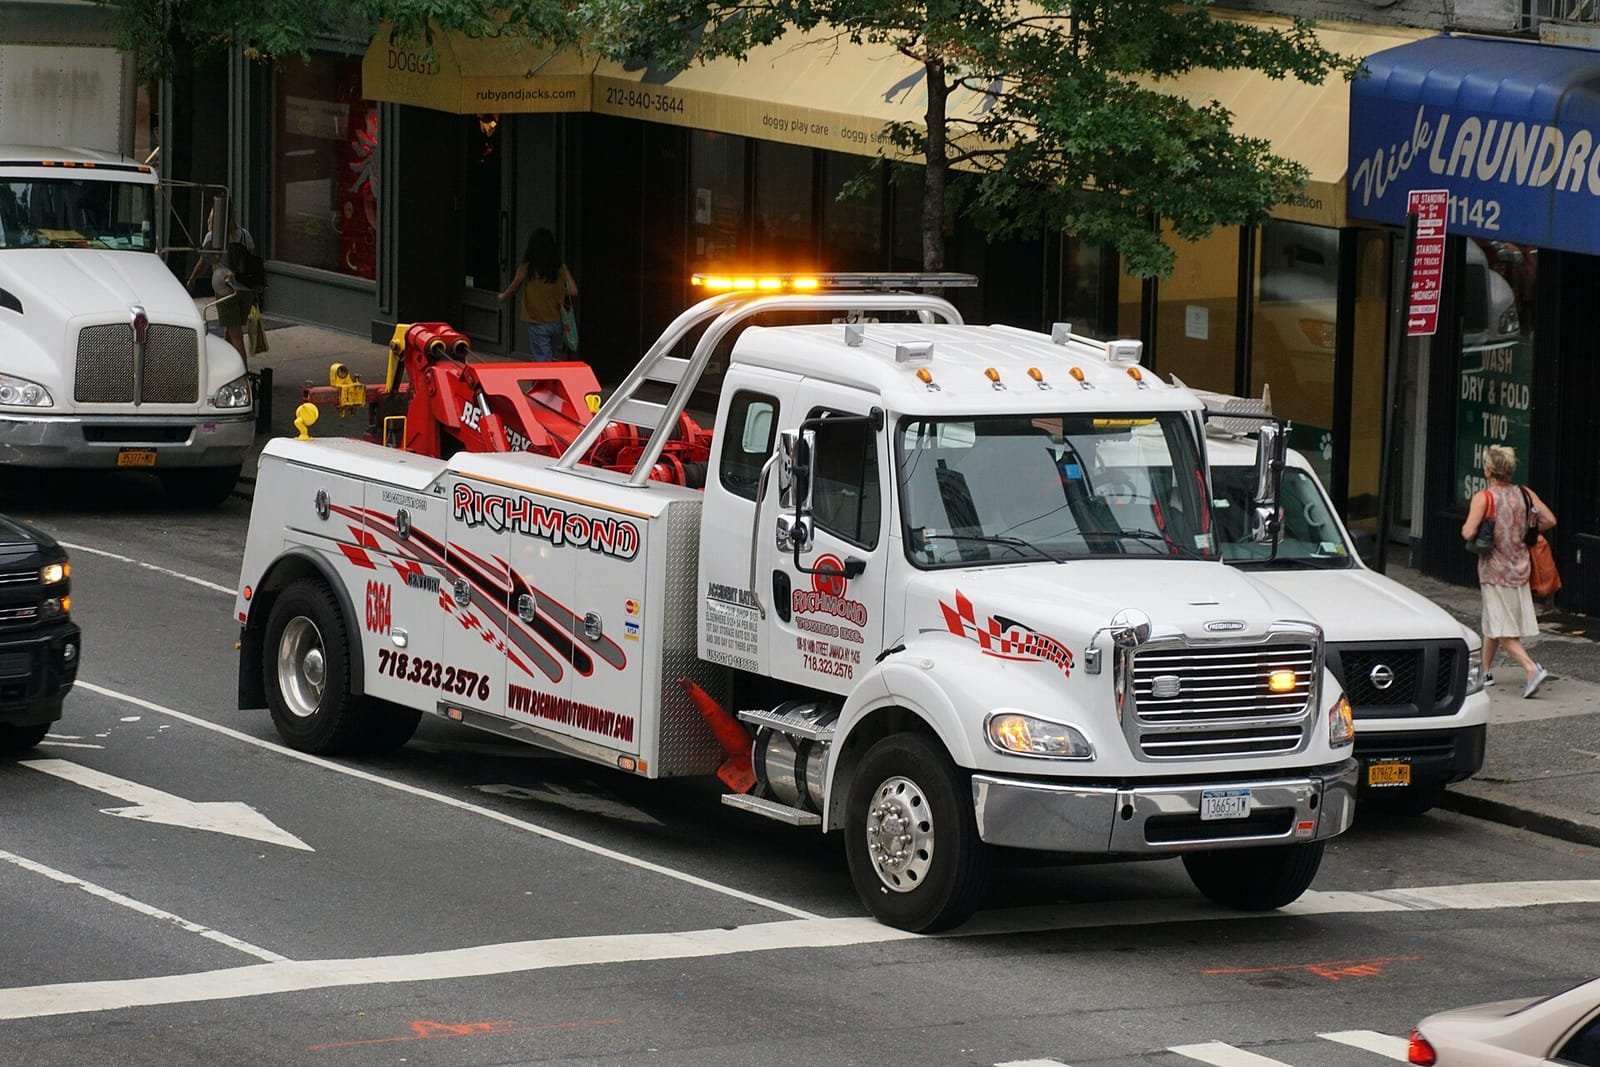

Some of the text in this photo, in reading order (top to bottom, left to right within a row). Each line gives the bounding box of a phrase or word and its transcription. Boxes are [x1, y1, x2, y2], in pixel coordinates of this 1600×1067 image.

[476, 88, 576, 101] rubyandjacks.com
[606, 88, 684, 114] 212-840-3644
[762, 114, 829, 136] doggy play care
[841, 128, 868, 144] doggy
[1352, 104, 1433, 206] Nick
[1411, 193, 1446, 204] NO STANDING
[1449, 195, 1500, 231] 1142
[1416, 244, 1441, 255] STANDING
[1482, 346, 1513, 374] WASH
[1461, 375, 1530, 411] DRY & FOLD
[1482, 412, 1508, 441] TWO
[453, 483, 640, 562] RICHMOND
[366, 578, 391, 636] 6364
[793, 588, 868, 628] RICHMOND
[626, 627, 637, 636] VISA
[795, 616, 865, 644] TOWING INC.
[378, 648, 490, 701] 718.323.2576
